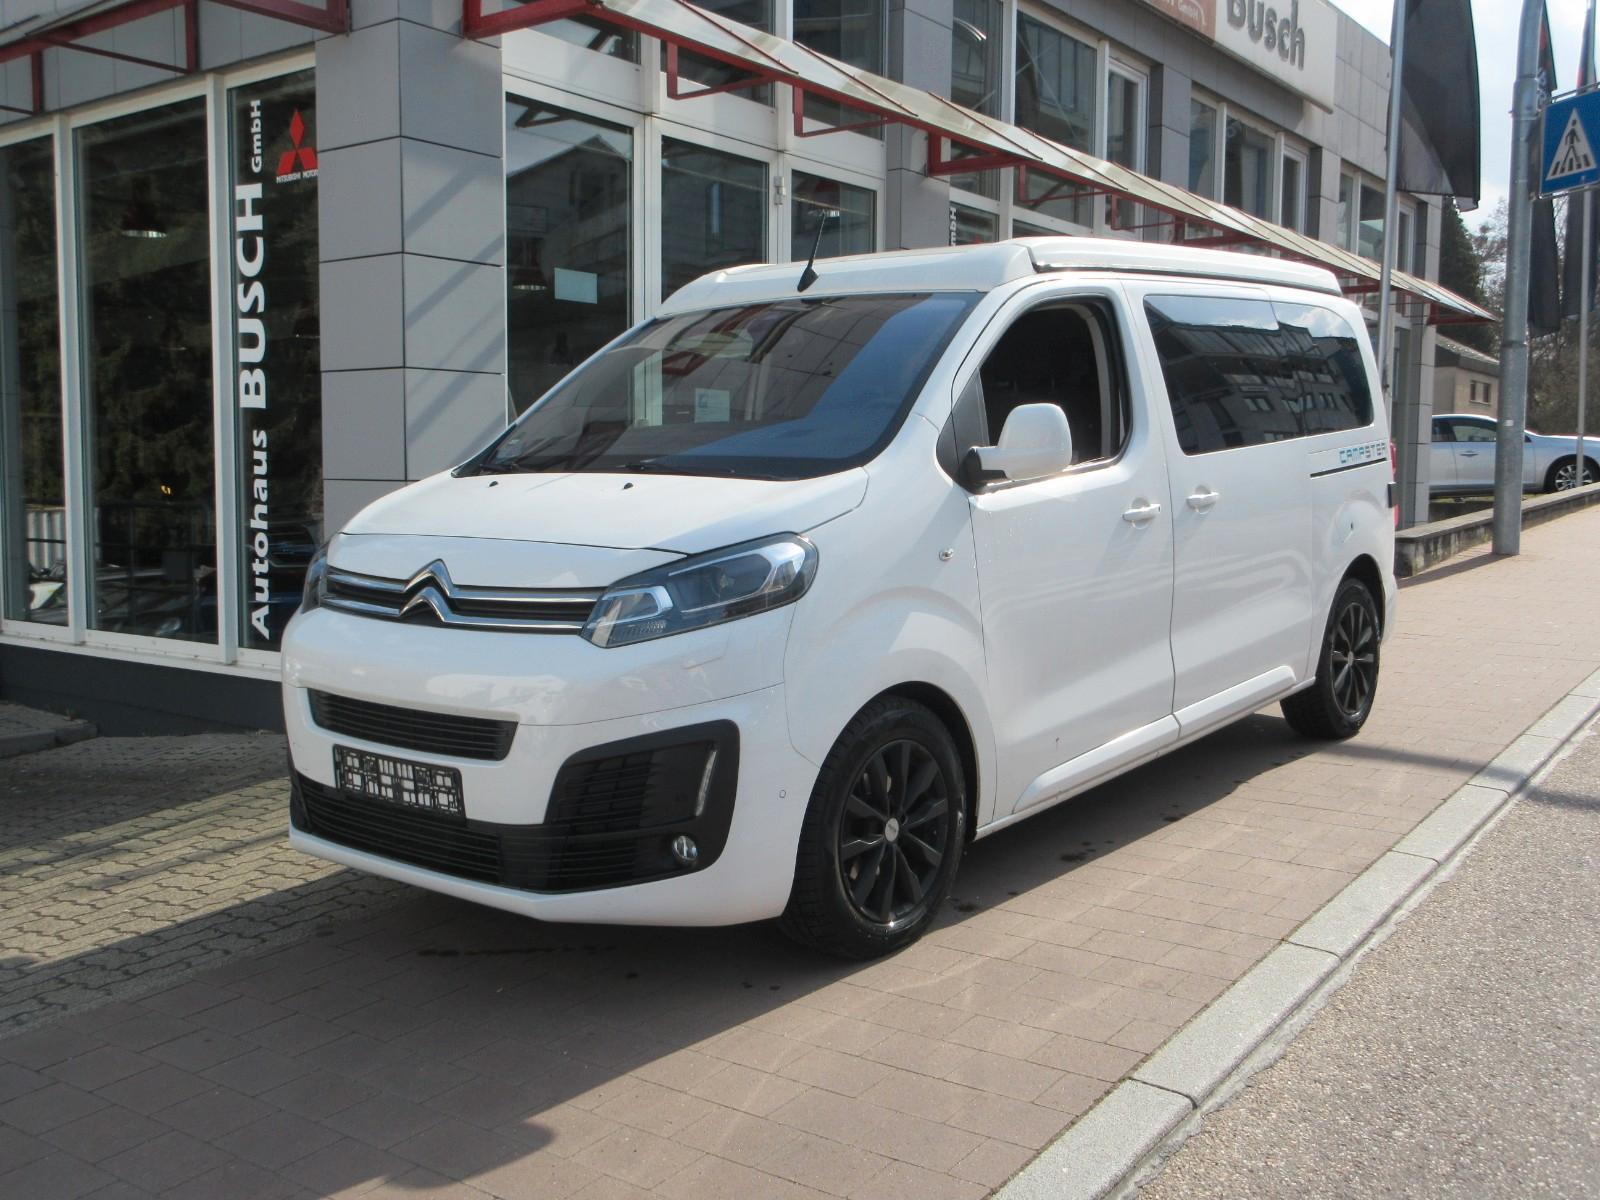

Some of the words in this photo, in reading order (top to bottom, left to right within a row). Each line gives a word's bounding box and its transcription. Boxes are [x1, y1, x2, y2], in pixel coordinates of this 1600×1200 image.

[250, 99, 262, 174] GmbH
[302, 168, 318, 178] MOTOR
[235, 182, 267, 409] BUSCH
[250, 429, 270, 641] Autohaus
